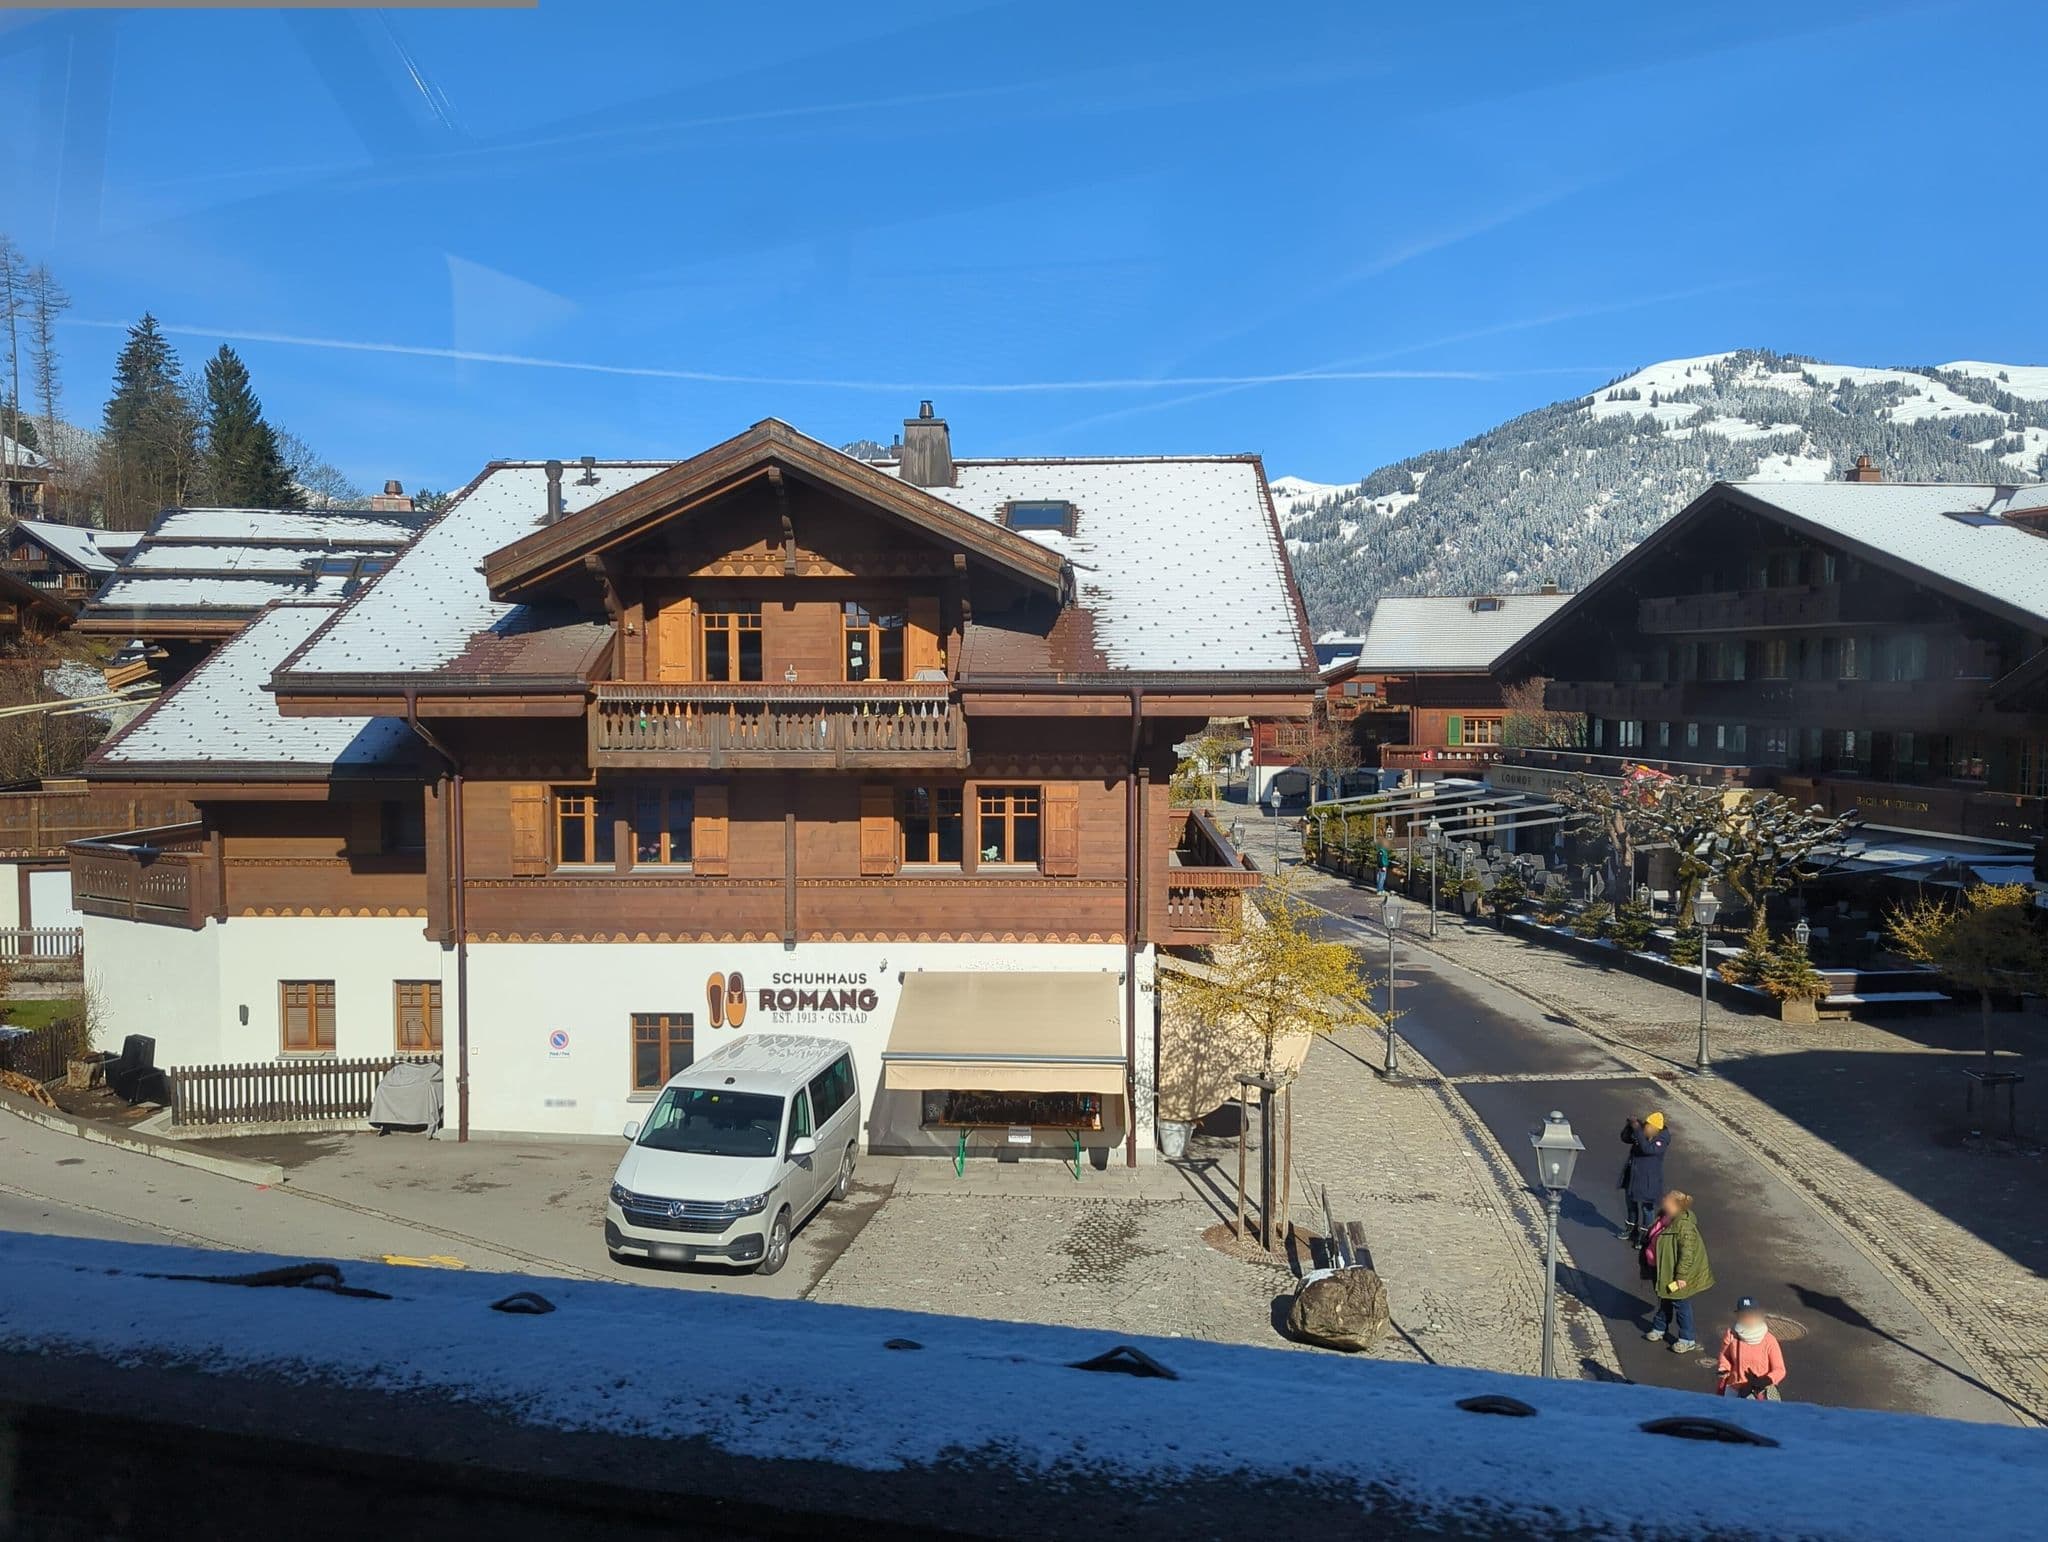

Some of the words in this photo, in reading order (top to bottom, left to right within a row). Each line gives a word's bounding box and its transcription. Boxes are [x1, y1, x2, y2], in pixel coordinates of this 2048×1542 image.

[772, 972, 867, 984] SCHUHHAUS
[759, 988, 879, 1012] ROMANG
[772, 1012, 793, 1024] EST.
[796, 1012, 817, 1024] 1913
[828, 1012, 868, 1024] GSTAAD
